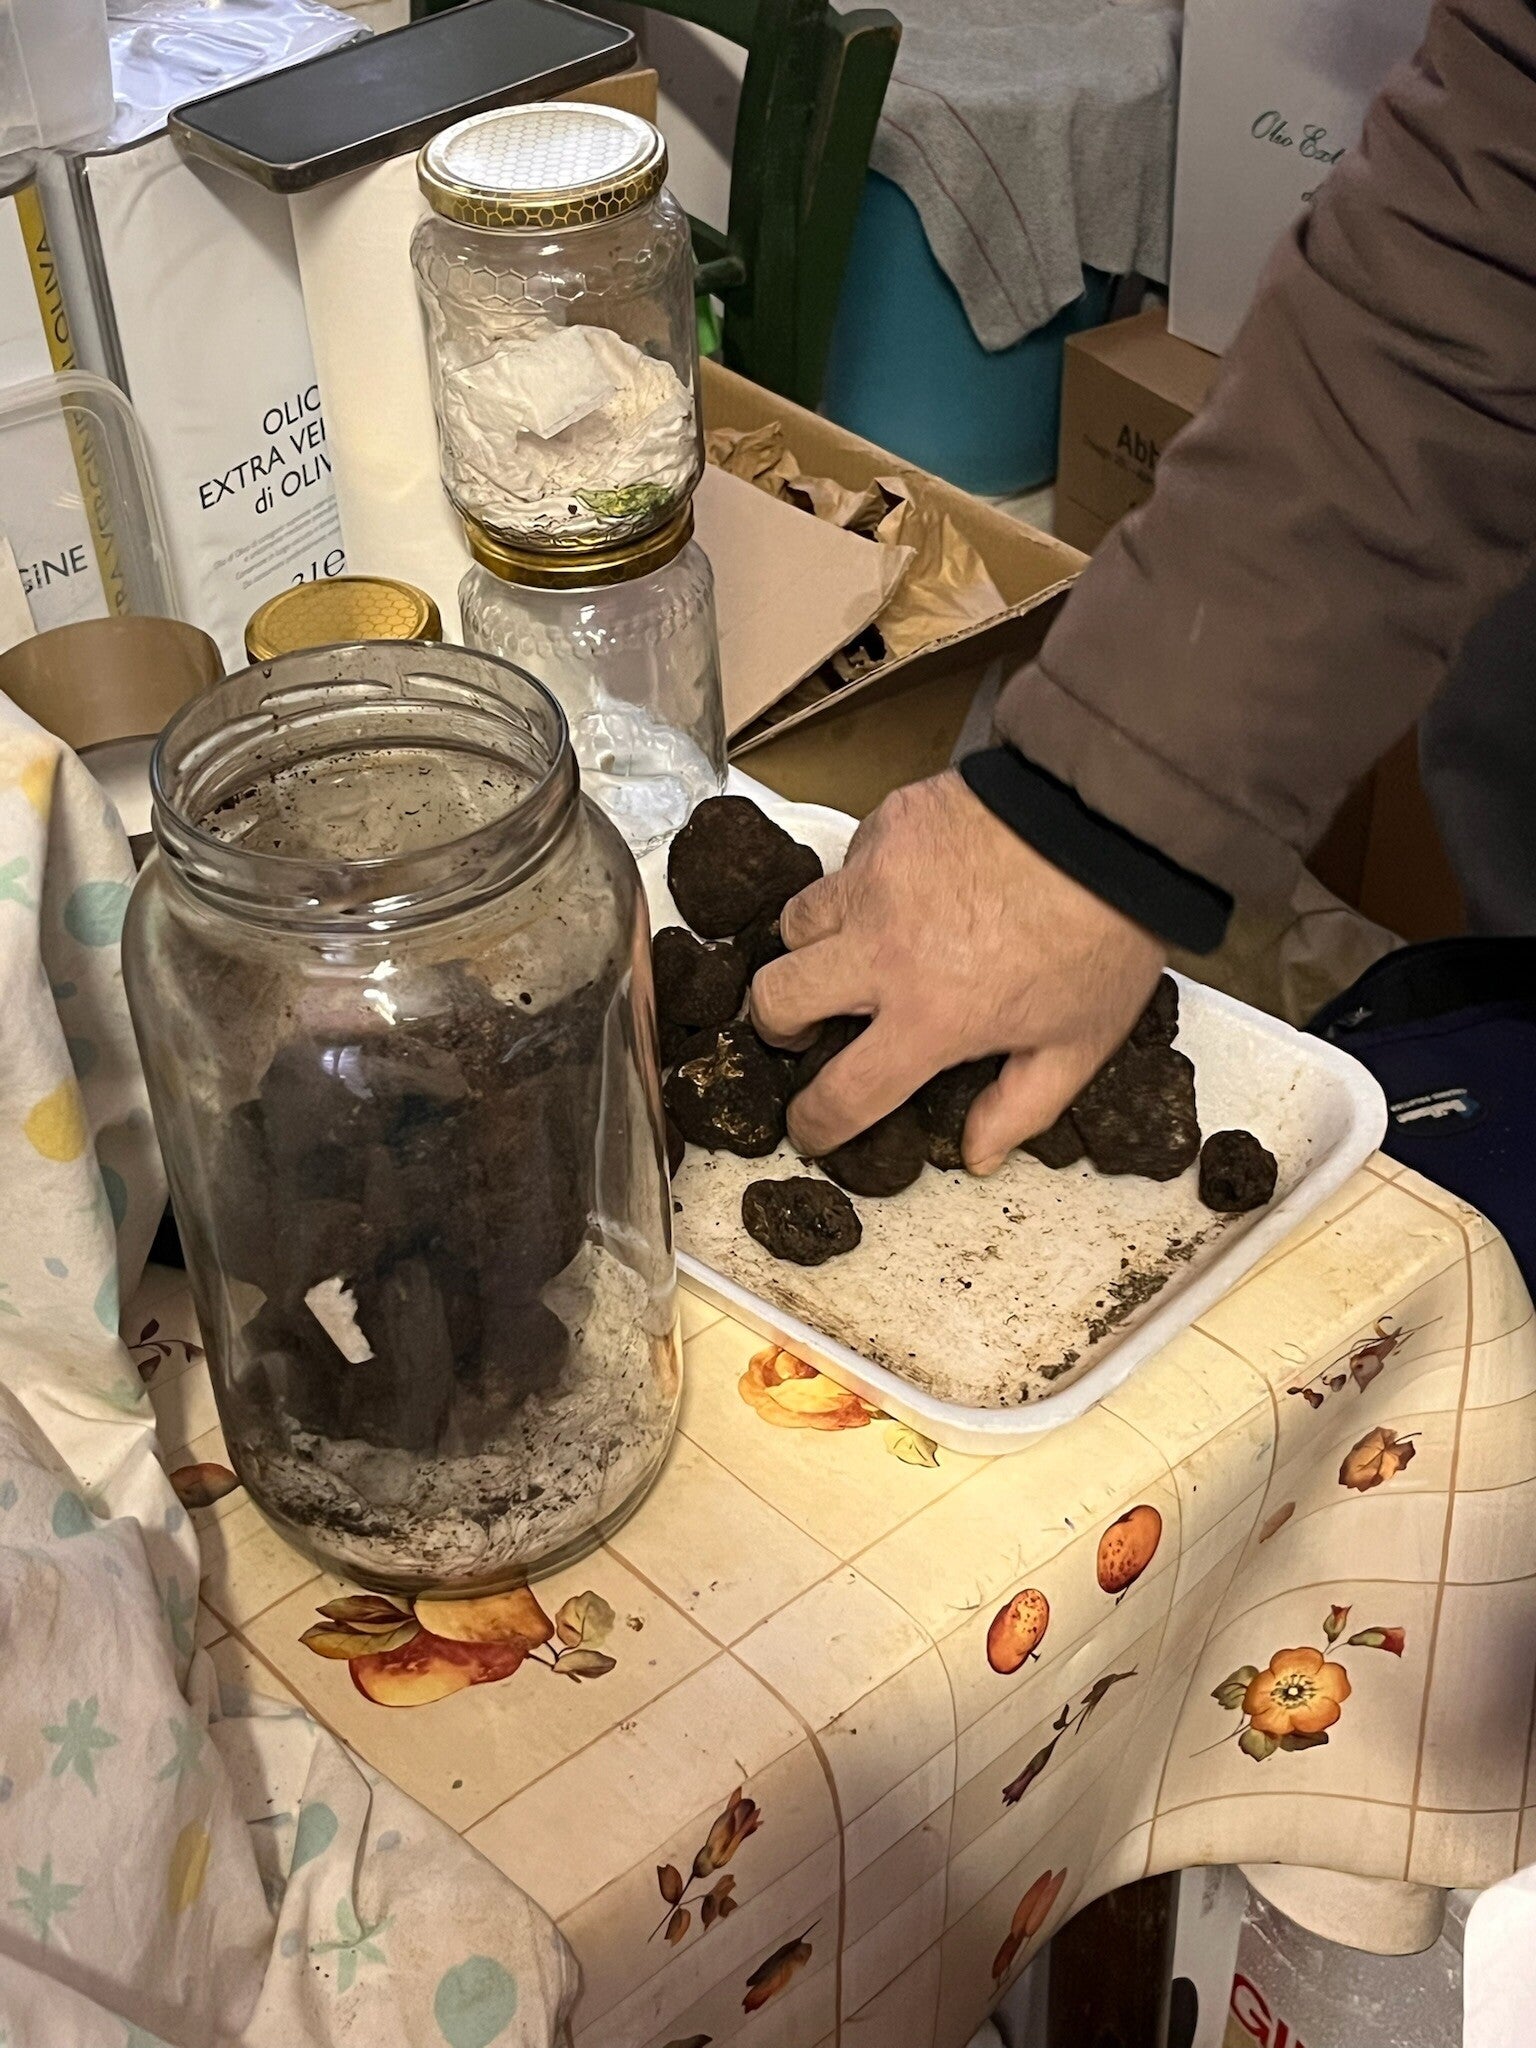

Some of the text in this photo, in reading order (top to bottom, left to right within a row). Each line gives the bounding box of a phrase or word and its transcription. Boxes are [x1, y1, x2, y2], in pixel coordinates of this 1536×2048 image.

[199, 417, 326, 510] EXTRA VE
[255, 486, 274, 514] di
